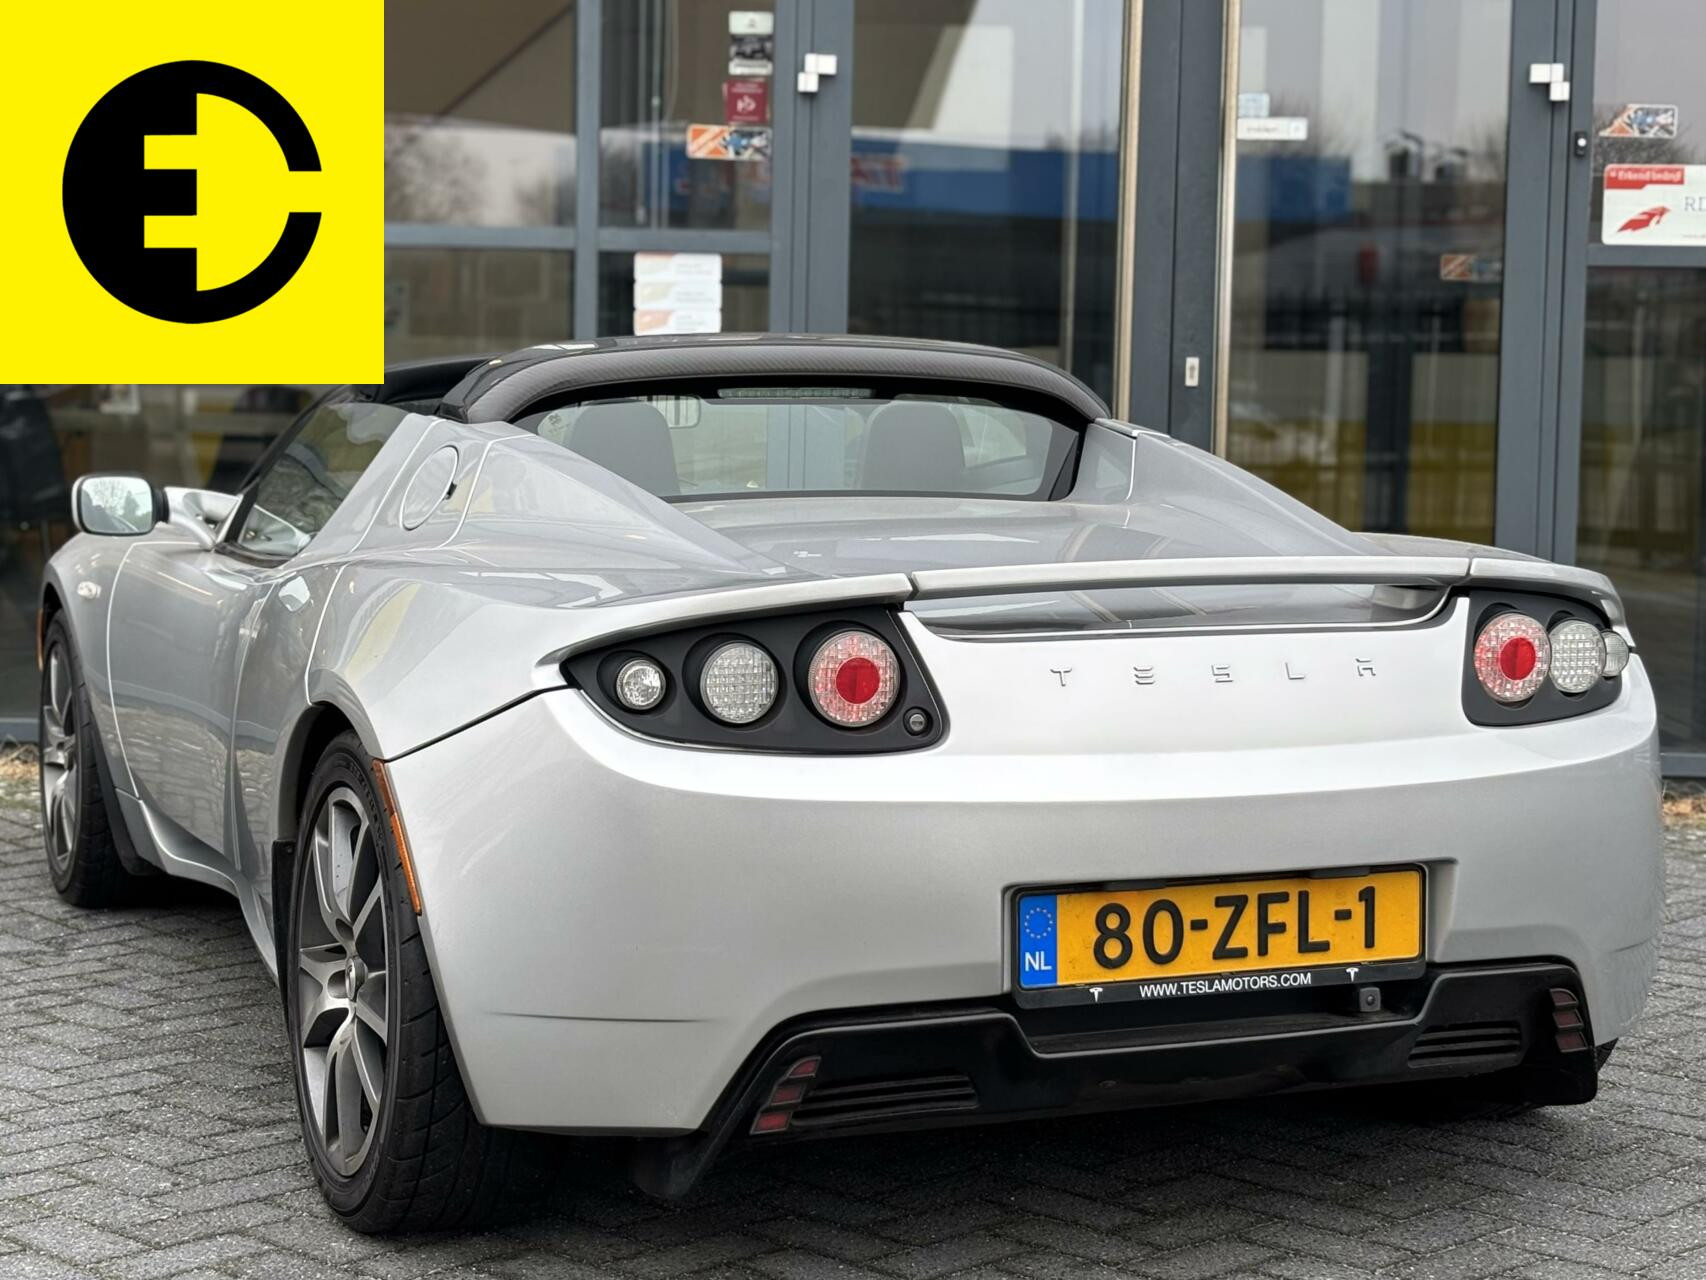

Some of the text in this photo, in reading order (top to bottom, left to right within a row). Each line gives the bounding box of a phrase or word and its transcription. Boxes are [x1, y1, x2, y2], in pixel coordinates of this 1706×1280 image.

[1050, 657, 1377, 687] TESLA
[1093, 885, 1376, 970] 80-ZFL-1
[1024, 951, 1052, 972] NL
[1139, 972, 1312, 998] WWW.TESLAMOTORS.COM
